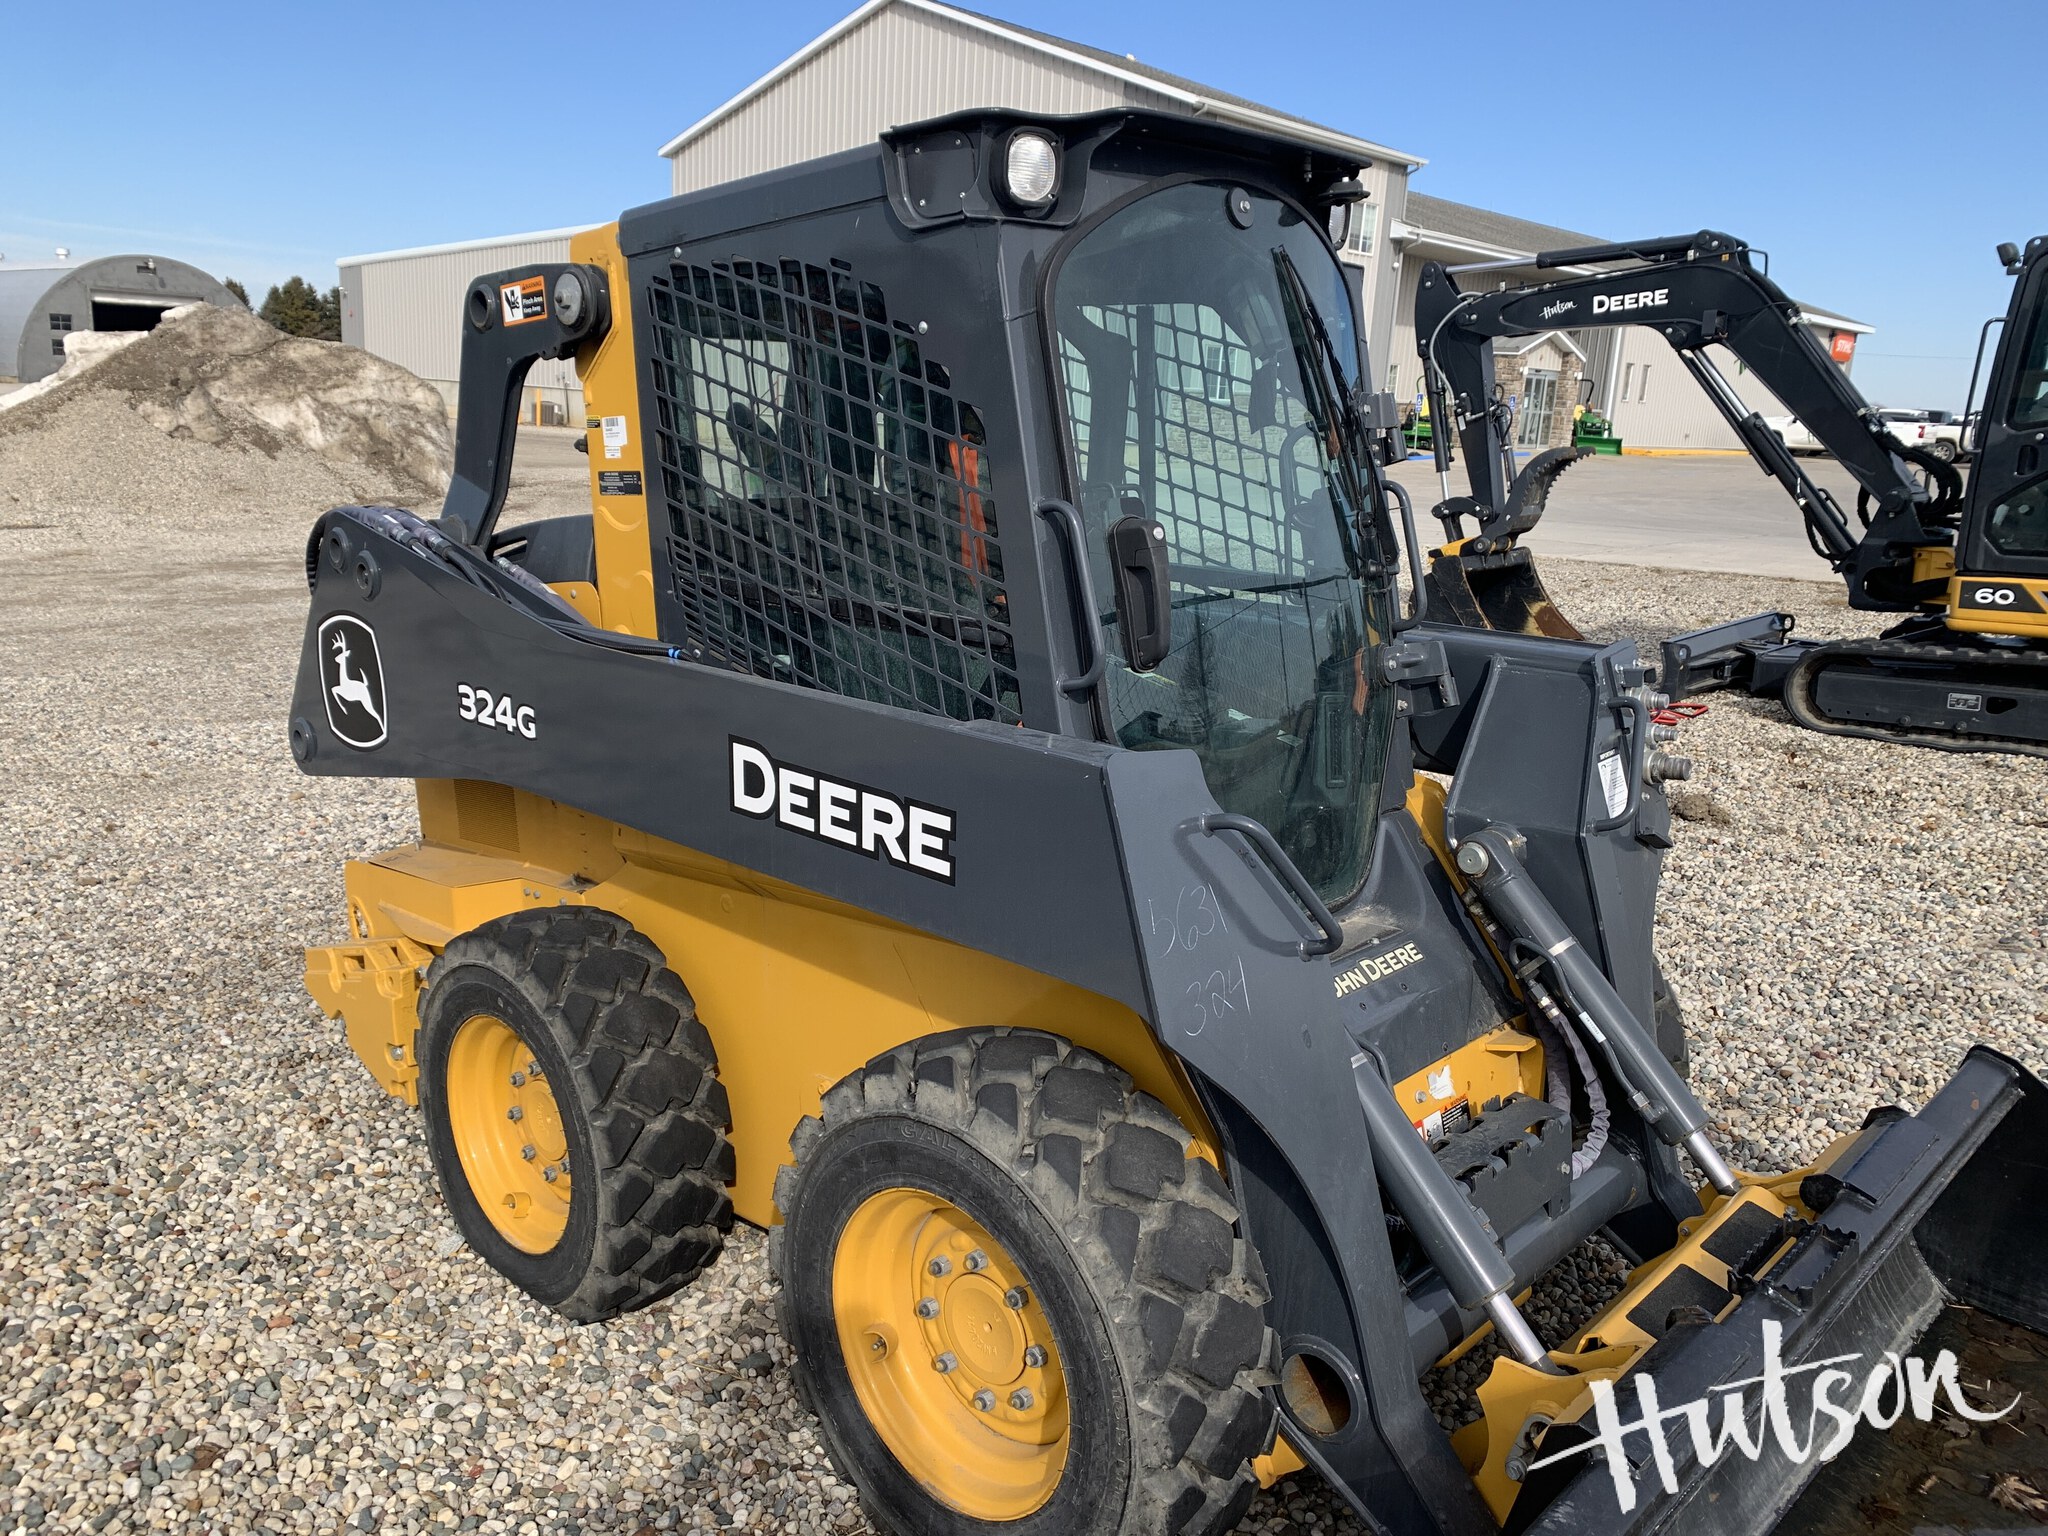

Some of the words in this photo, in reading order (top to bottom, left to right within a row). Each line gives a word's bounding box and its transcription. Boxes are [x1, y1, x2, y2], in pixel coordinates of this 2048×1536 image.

[1538, 299, 1578, 320] Hutson
[1592, 288, 1669, 315] DEERE
[1974, 587, 2016, 605] 60
[457, 683, 537, 739] 324G
[732, 741, 952, 878] DEERE
[1148, 881, 1229, 959] 5631
[1359, 942, 1424, 982] DEERE
[1184, 954, 1251, 1037] 324
